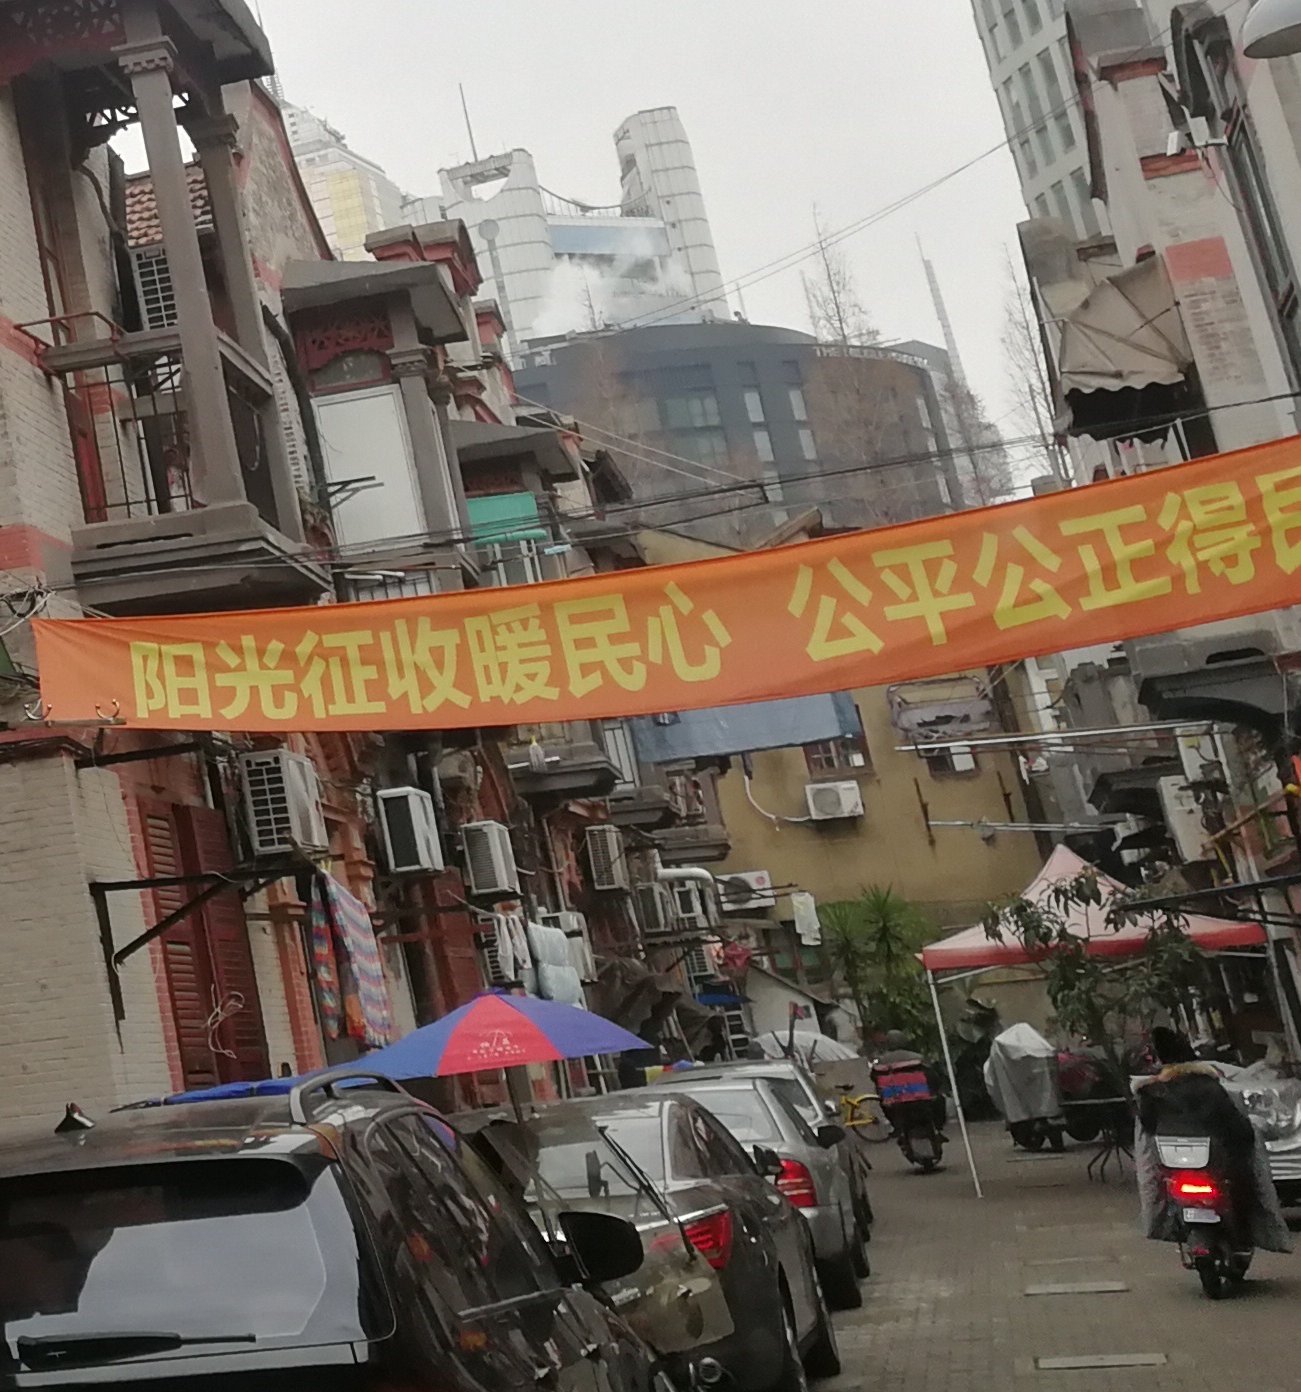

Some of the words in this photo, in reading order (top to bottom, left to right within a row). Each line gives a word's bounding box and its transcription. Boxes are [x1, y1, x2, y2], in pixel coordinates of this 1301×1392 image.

[130, 581, 732, 720] 阳光征收暖民心
